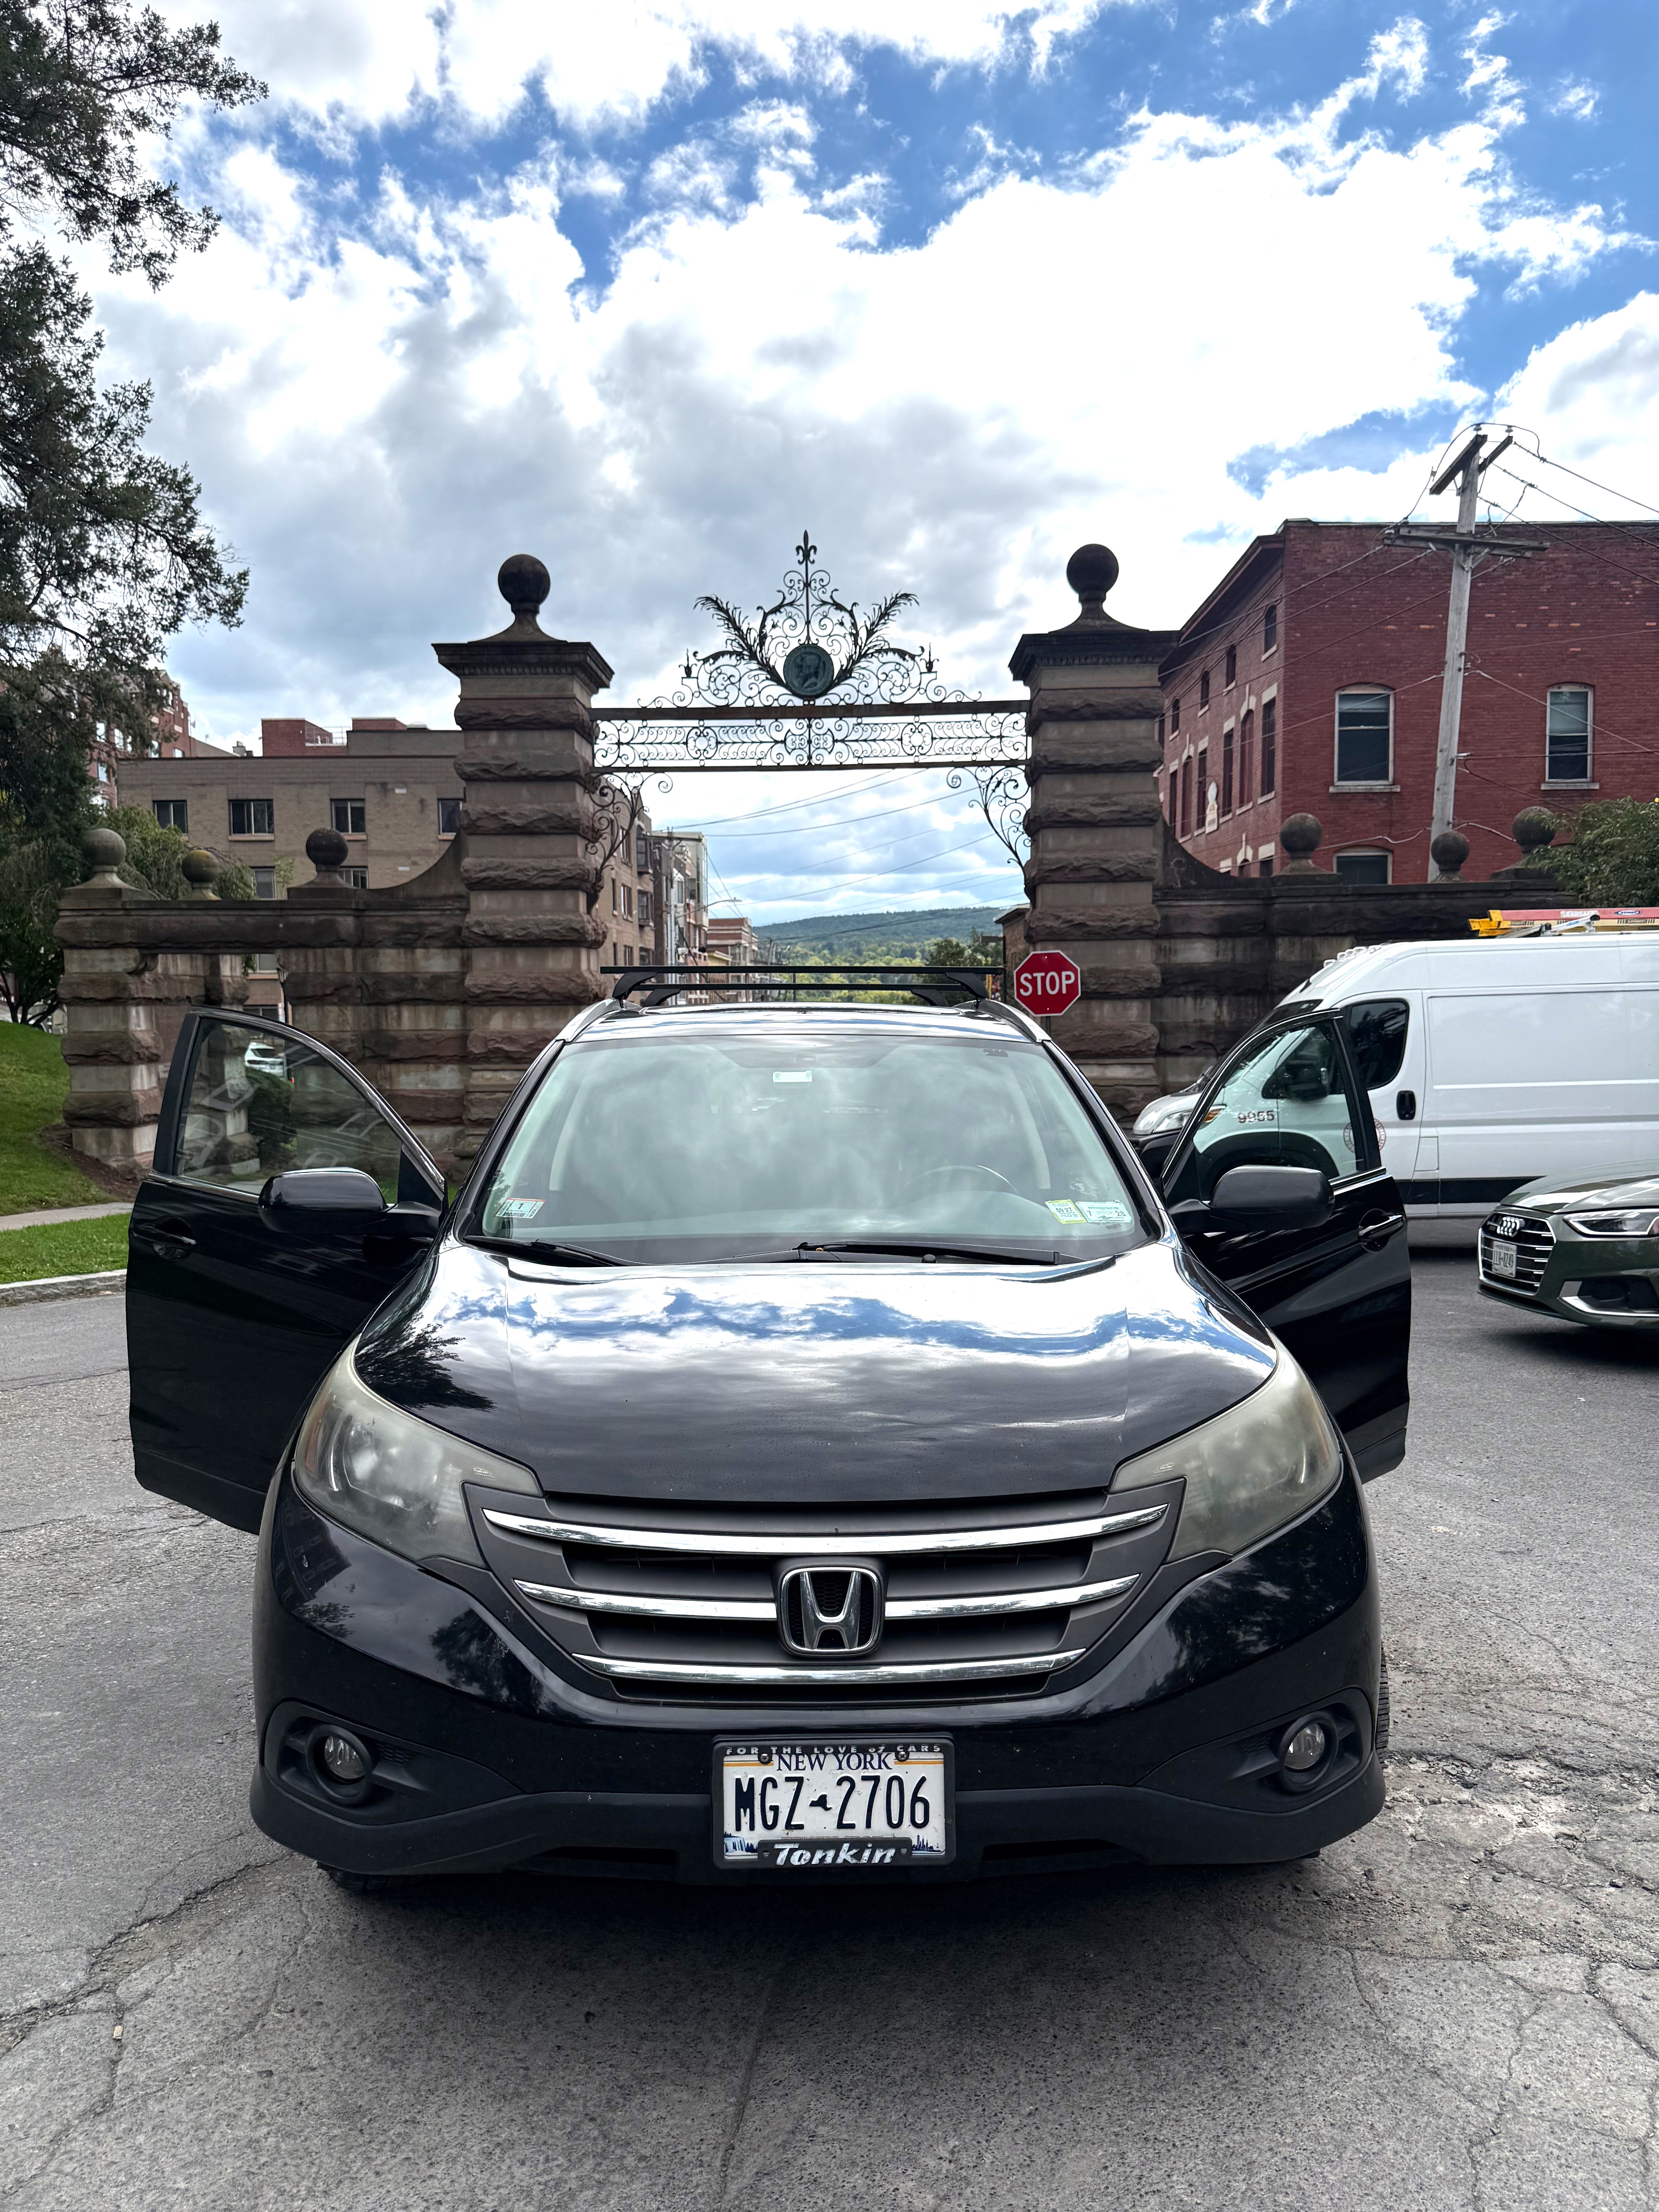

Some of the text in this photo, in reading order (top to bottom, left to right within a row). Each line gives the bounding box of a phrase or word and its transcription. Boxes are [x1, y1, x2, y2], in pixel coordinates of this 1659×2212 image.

[1020, 971, 1075, 996] STOP
[1238, 1110, 1274, 1123] 9955
[814, 1745, 857, 1753] LOVE
[869, 1745, 886, 1753] of
[776, 1753, 892, 1771] NEW YORK
[735, 1775, 930, 1831] MGZ 2706
[774, 1842, 896, 1865] Tonkin
